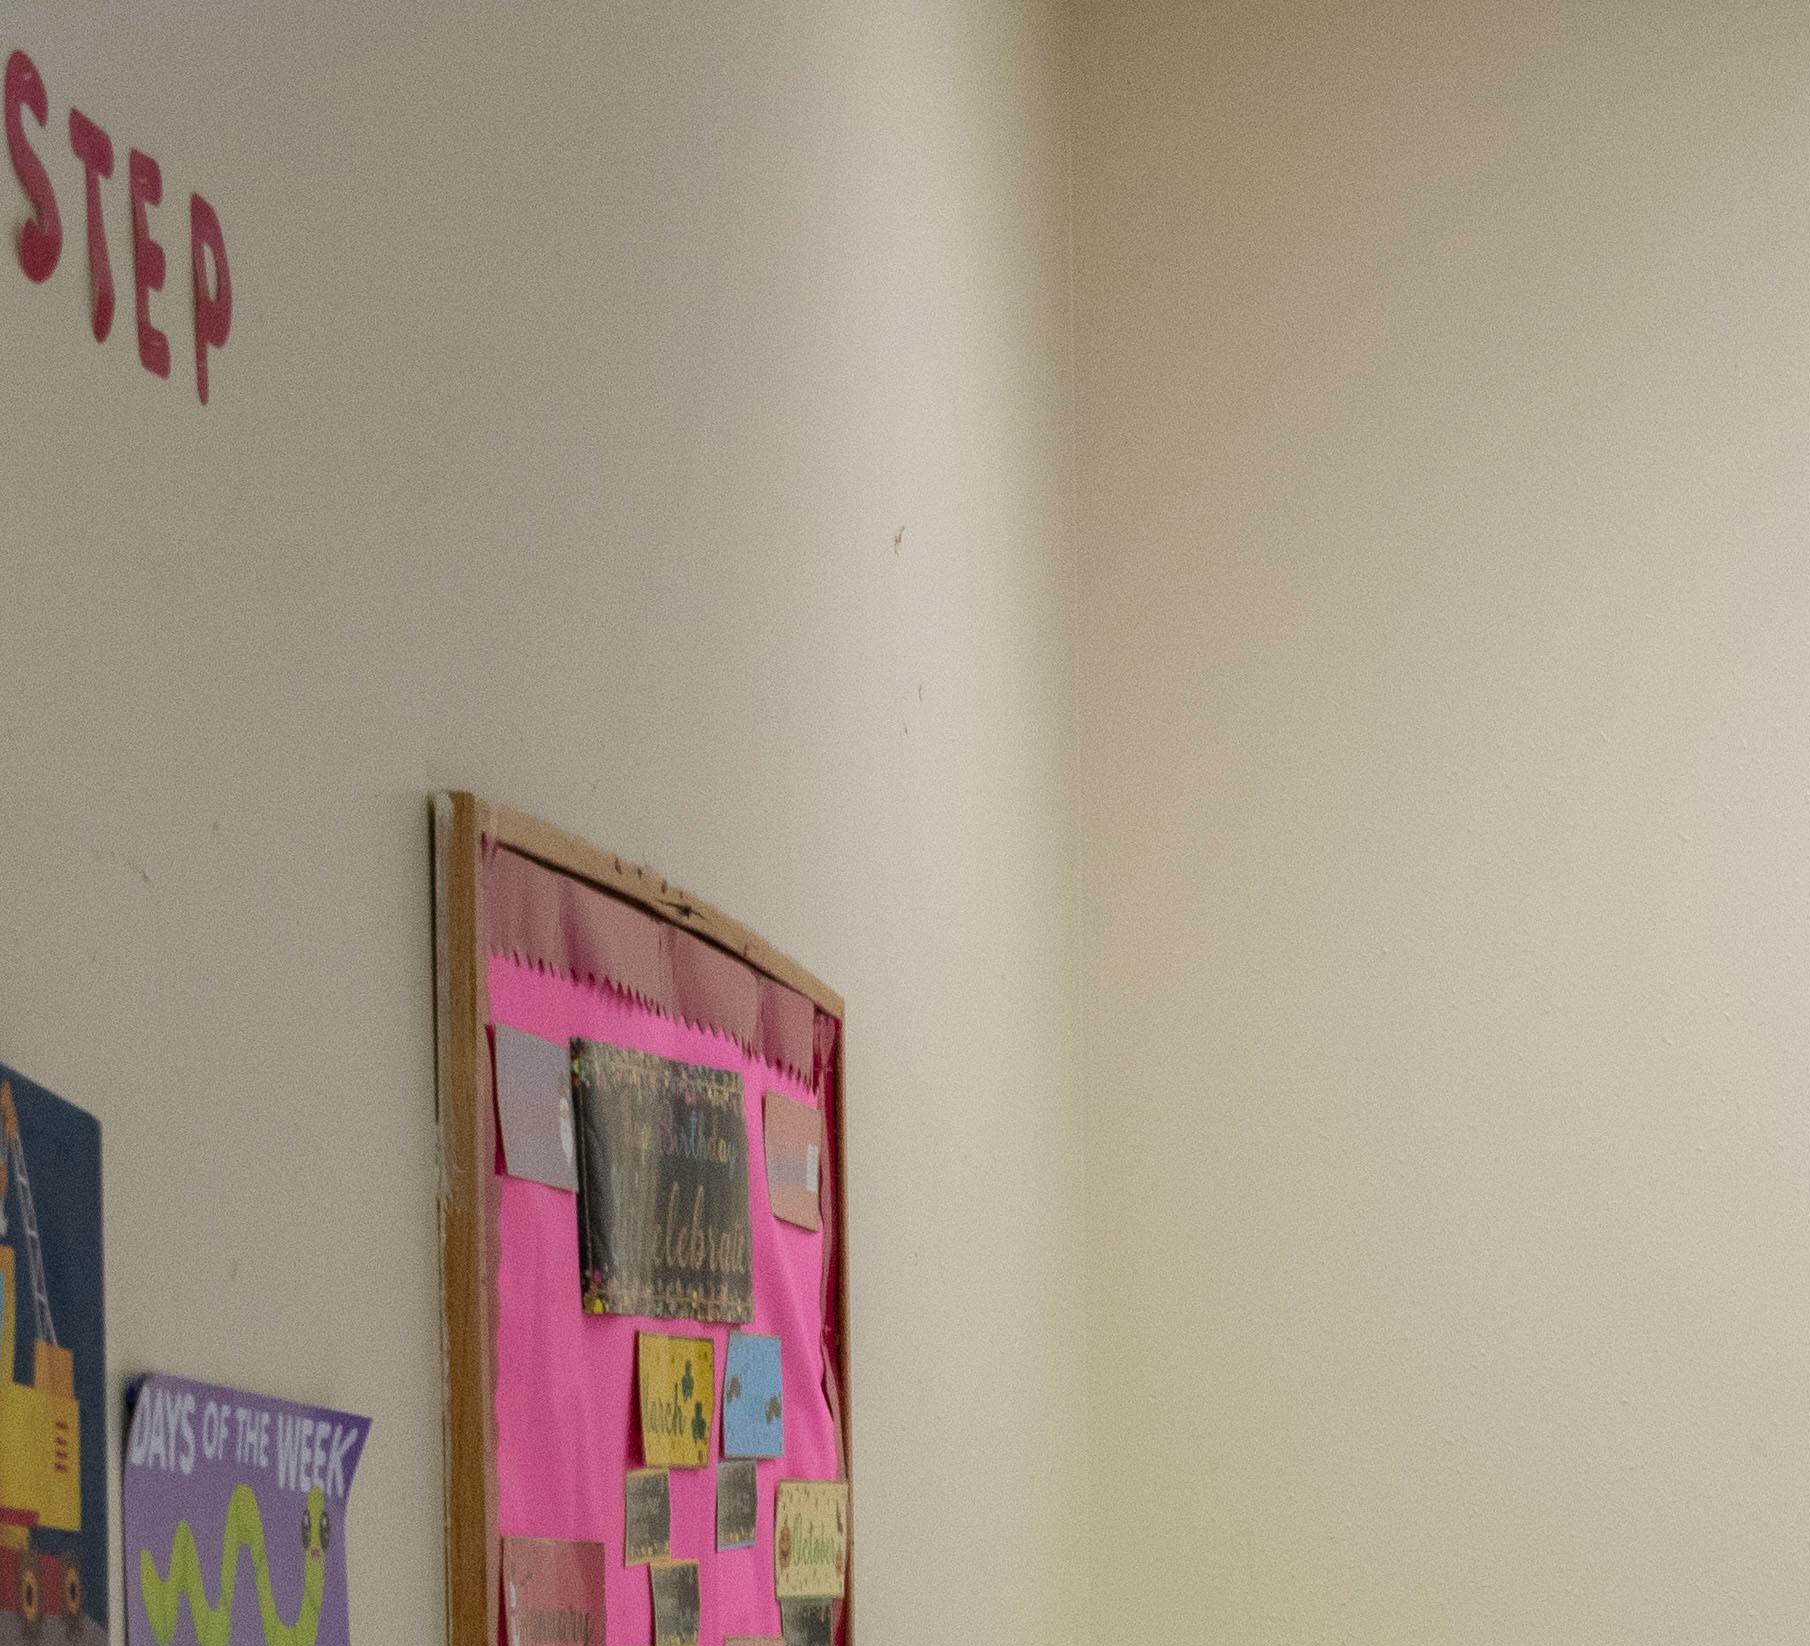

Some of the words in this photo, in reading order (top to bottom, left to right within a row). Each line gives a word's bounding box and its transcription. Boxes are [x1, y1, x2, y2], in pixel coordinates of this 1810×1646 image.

[4, 48, 233, 407] STEP
[203, 1400, 232, 1460] OF
[235, 1406, 271, 1468] THE
[277, 1411, 358, 1499] WEEK
